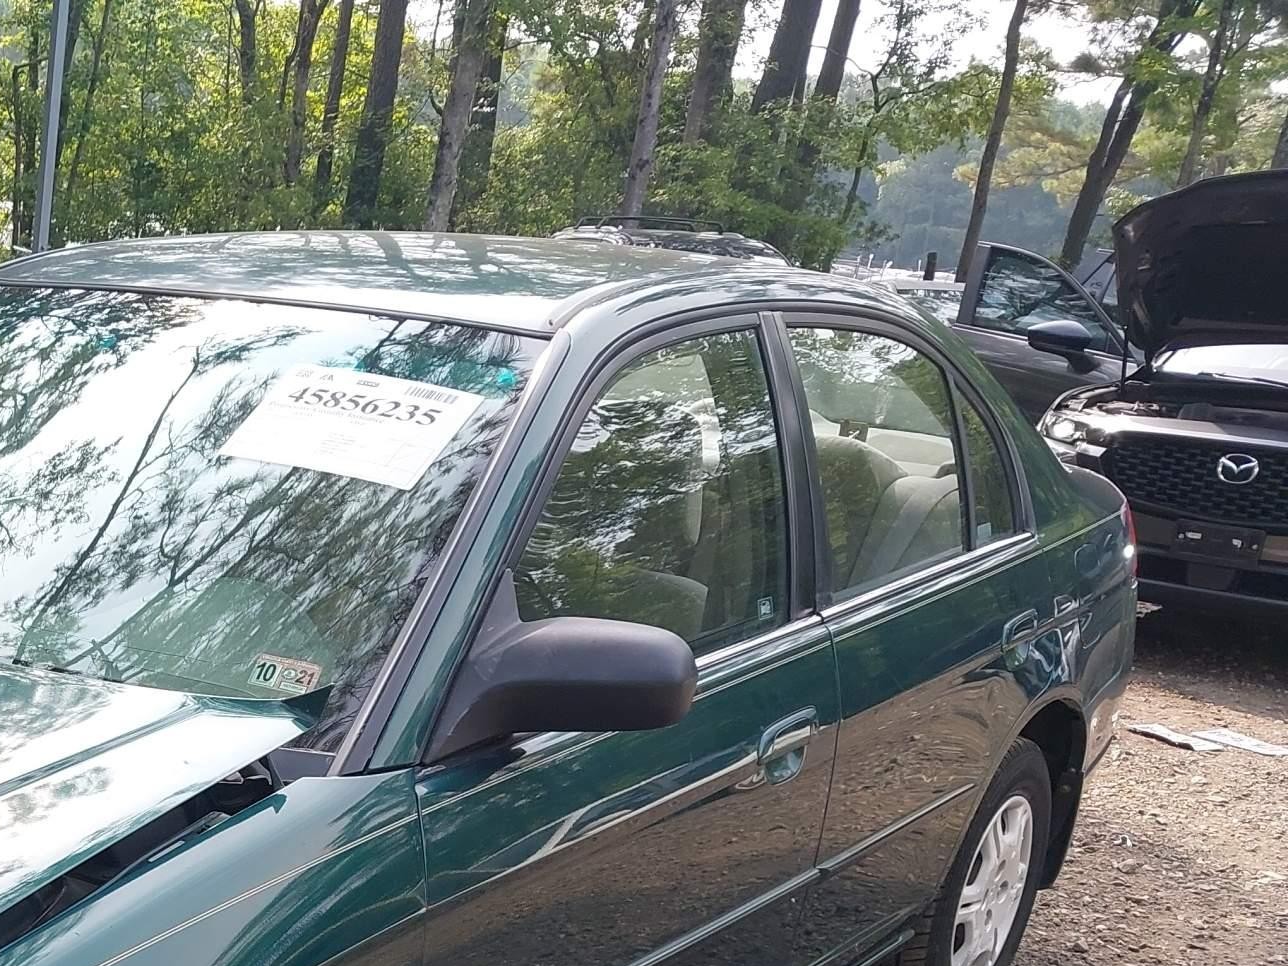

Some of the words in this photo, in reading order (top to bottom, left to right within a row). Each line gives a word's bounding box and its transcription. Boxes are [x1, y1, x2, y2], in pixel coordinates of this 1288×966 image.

[288, 387, 442, 425] 45856235
[256, 662, 277, 682] 10
[295, 670, 316, 685] 21
